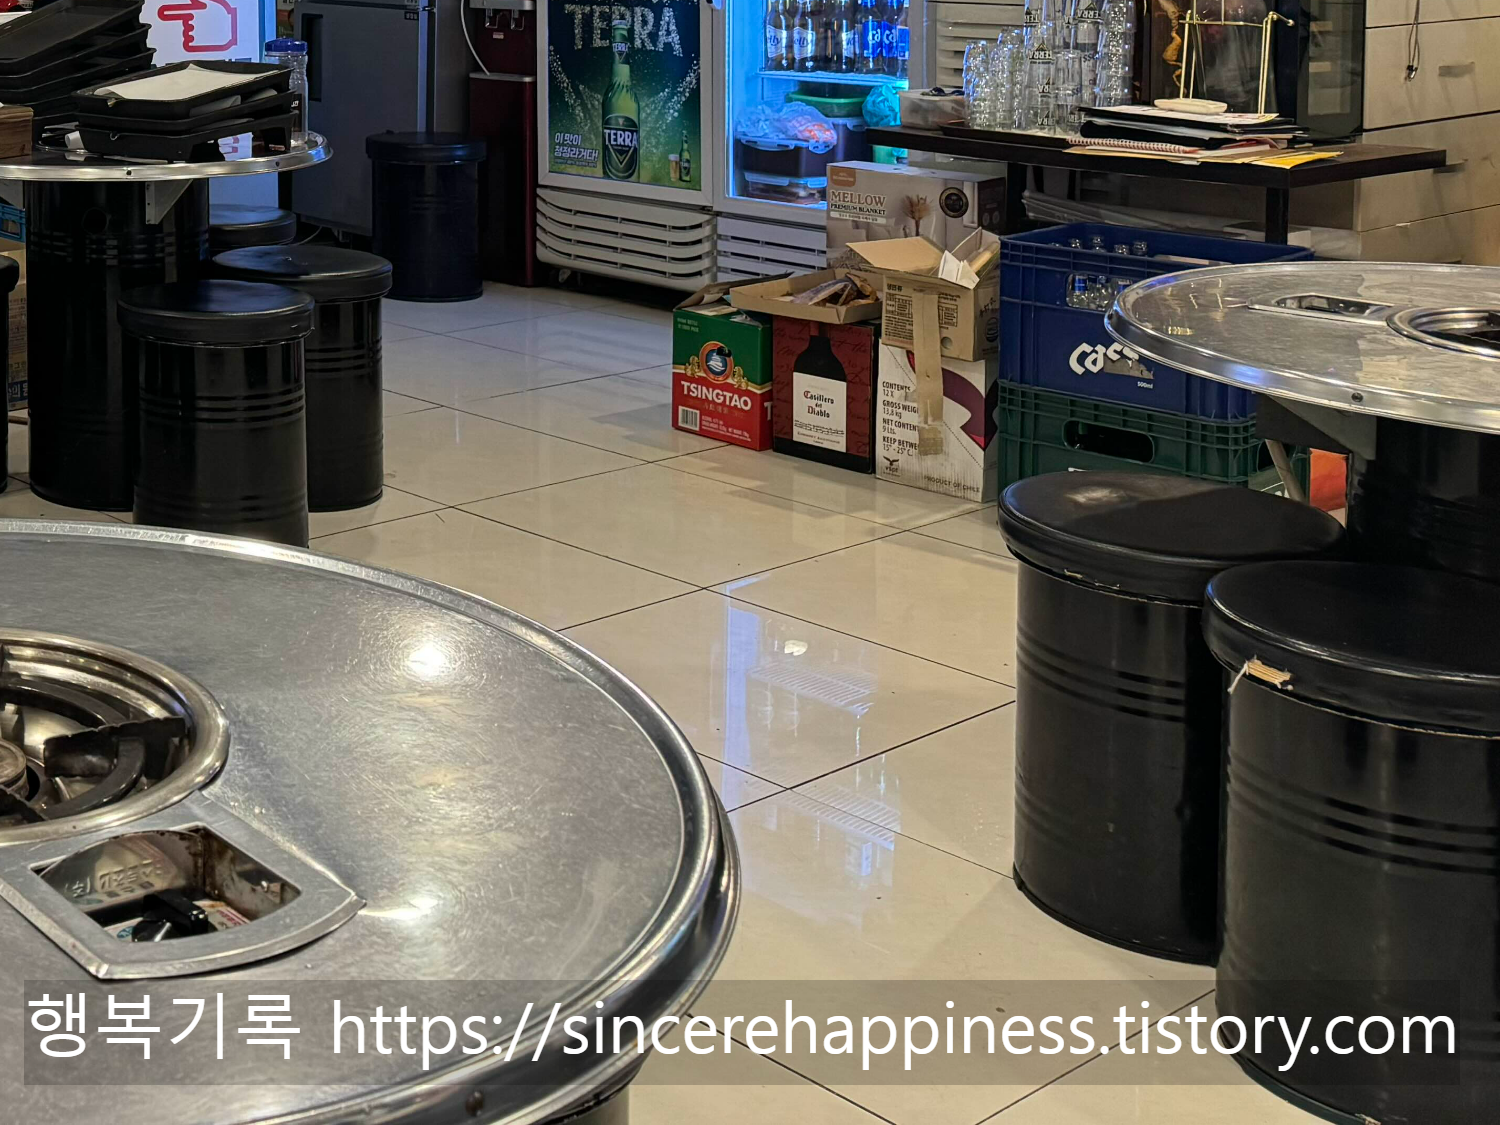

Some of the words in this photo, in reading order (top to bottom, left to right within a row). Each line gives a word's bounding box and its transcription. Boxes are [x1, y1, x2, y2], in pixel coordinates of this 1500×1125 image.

[563, 3, 684, 58] TERRA
[603, 128, 639, 146] TERRA
[554, 146, 599, 161] 청정라거다!
[830, 190, 886, 208] MELLOW
[830, 203, 858, 214] PREMIUM
[858, 206, 886, 216] BLANKET
[882, 380, 911, 392] CONTENTS
[1137, 381, 1154, 389] 500ml
[681, 380, 752, 411] TSINGTAO
[803, 390, 835, 405] Casillero
[882, 389, 890, 397] 12
[882, 400, 901, 410] GROSS
[807, 405, 831, 419] Diablo
[894, 410, 902, 420] kg
[882, 418, 894, 427] NET
[882, 435, 897, 446] KEEP
[924, 475, 952, 487] PRODUCT
[962, 483, 980, 493] CHILE
